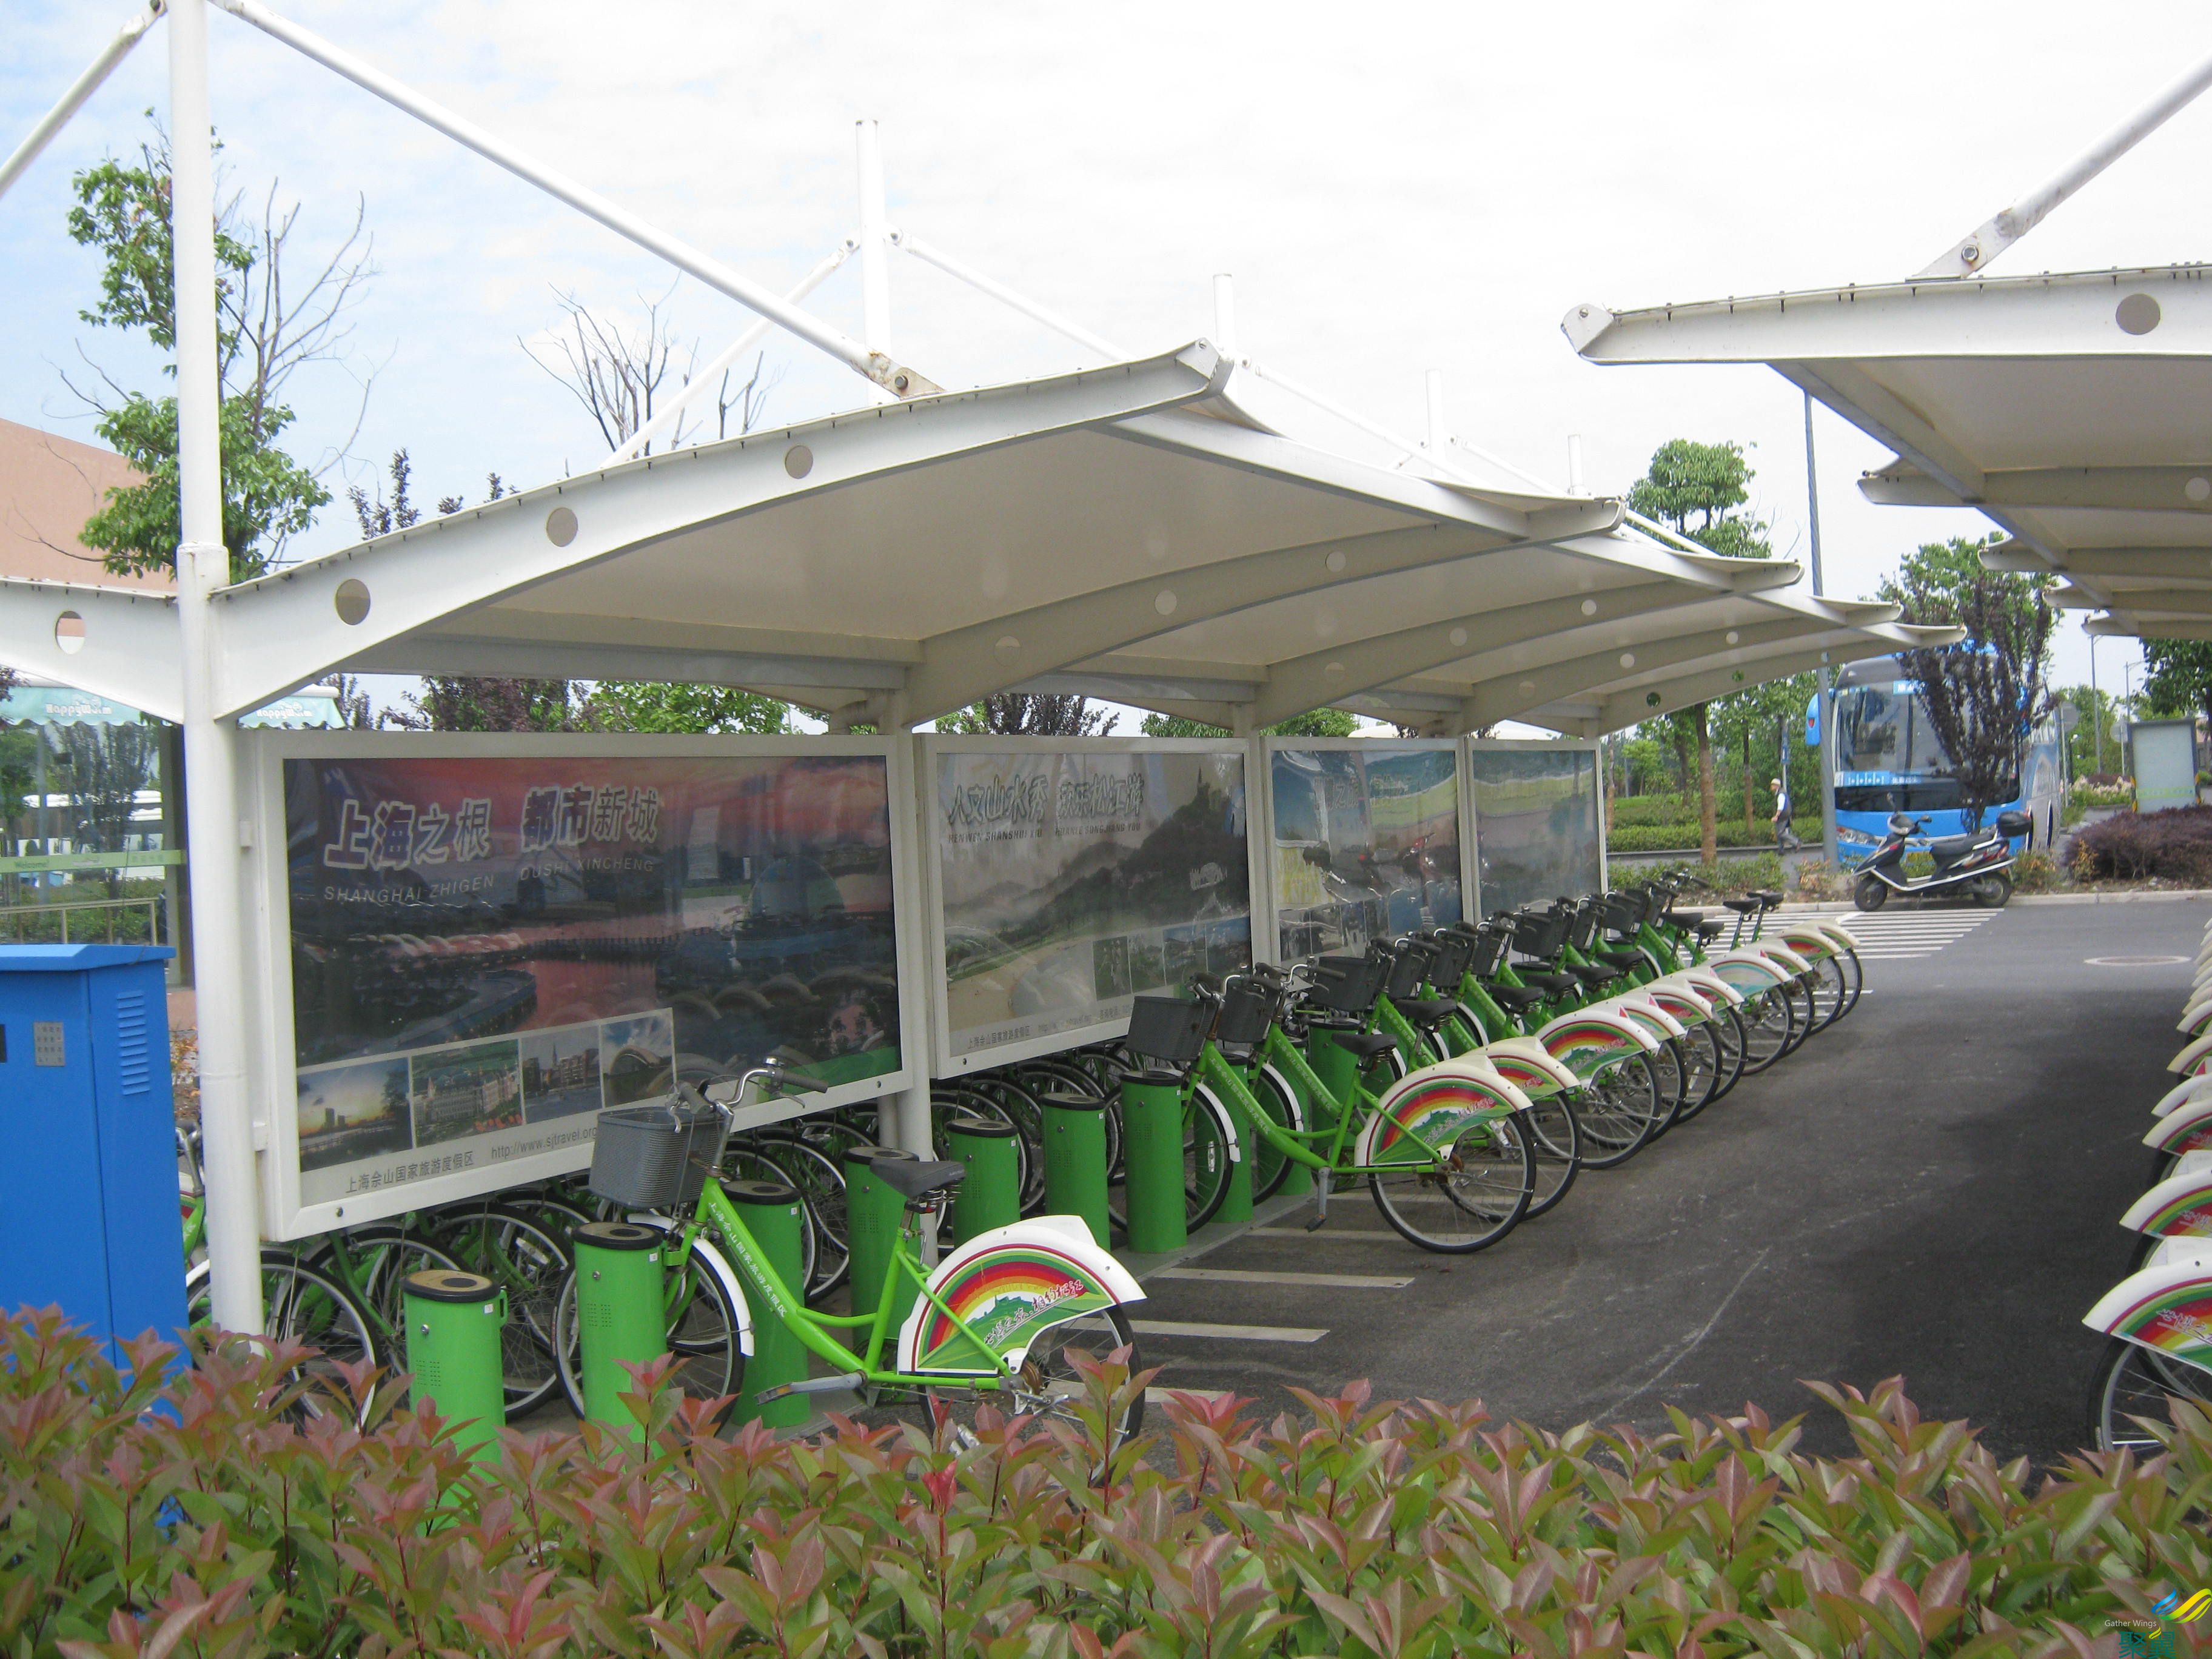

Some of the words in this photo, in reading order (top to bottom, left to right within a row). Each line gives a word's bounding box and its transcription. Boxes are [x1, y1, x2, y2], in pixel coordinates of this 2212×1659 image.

[949, 774, 1048, 825] 人文山水秀
[324, 797, 492, 871] 上海之根
[520, 782, 659, 853] 都市新城
[324, 886, 421, 903] SHANGHAI
[429, 874, 494, 899] ZHIGEN
[520, 861, 570, 881] DUSHI
[577, 857, 654, 872] XINCHENG
[346, 1151, 474, 1193] 上海佘山国家旅游度假区
[708, 1202, 787, 1318] 上海佘山国家旅游度假区
